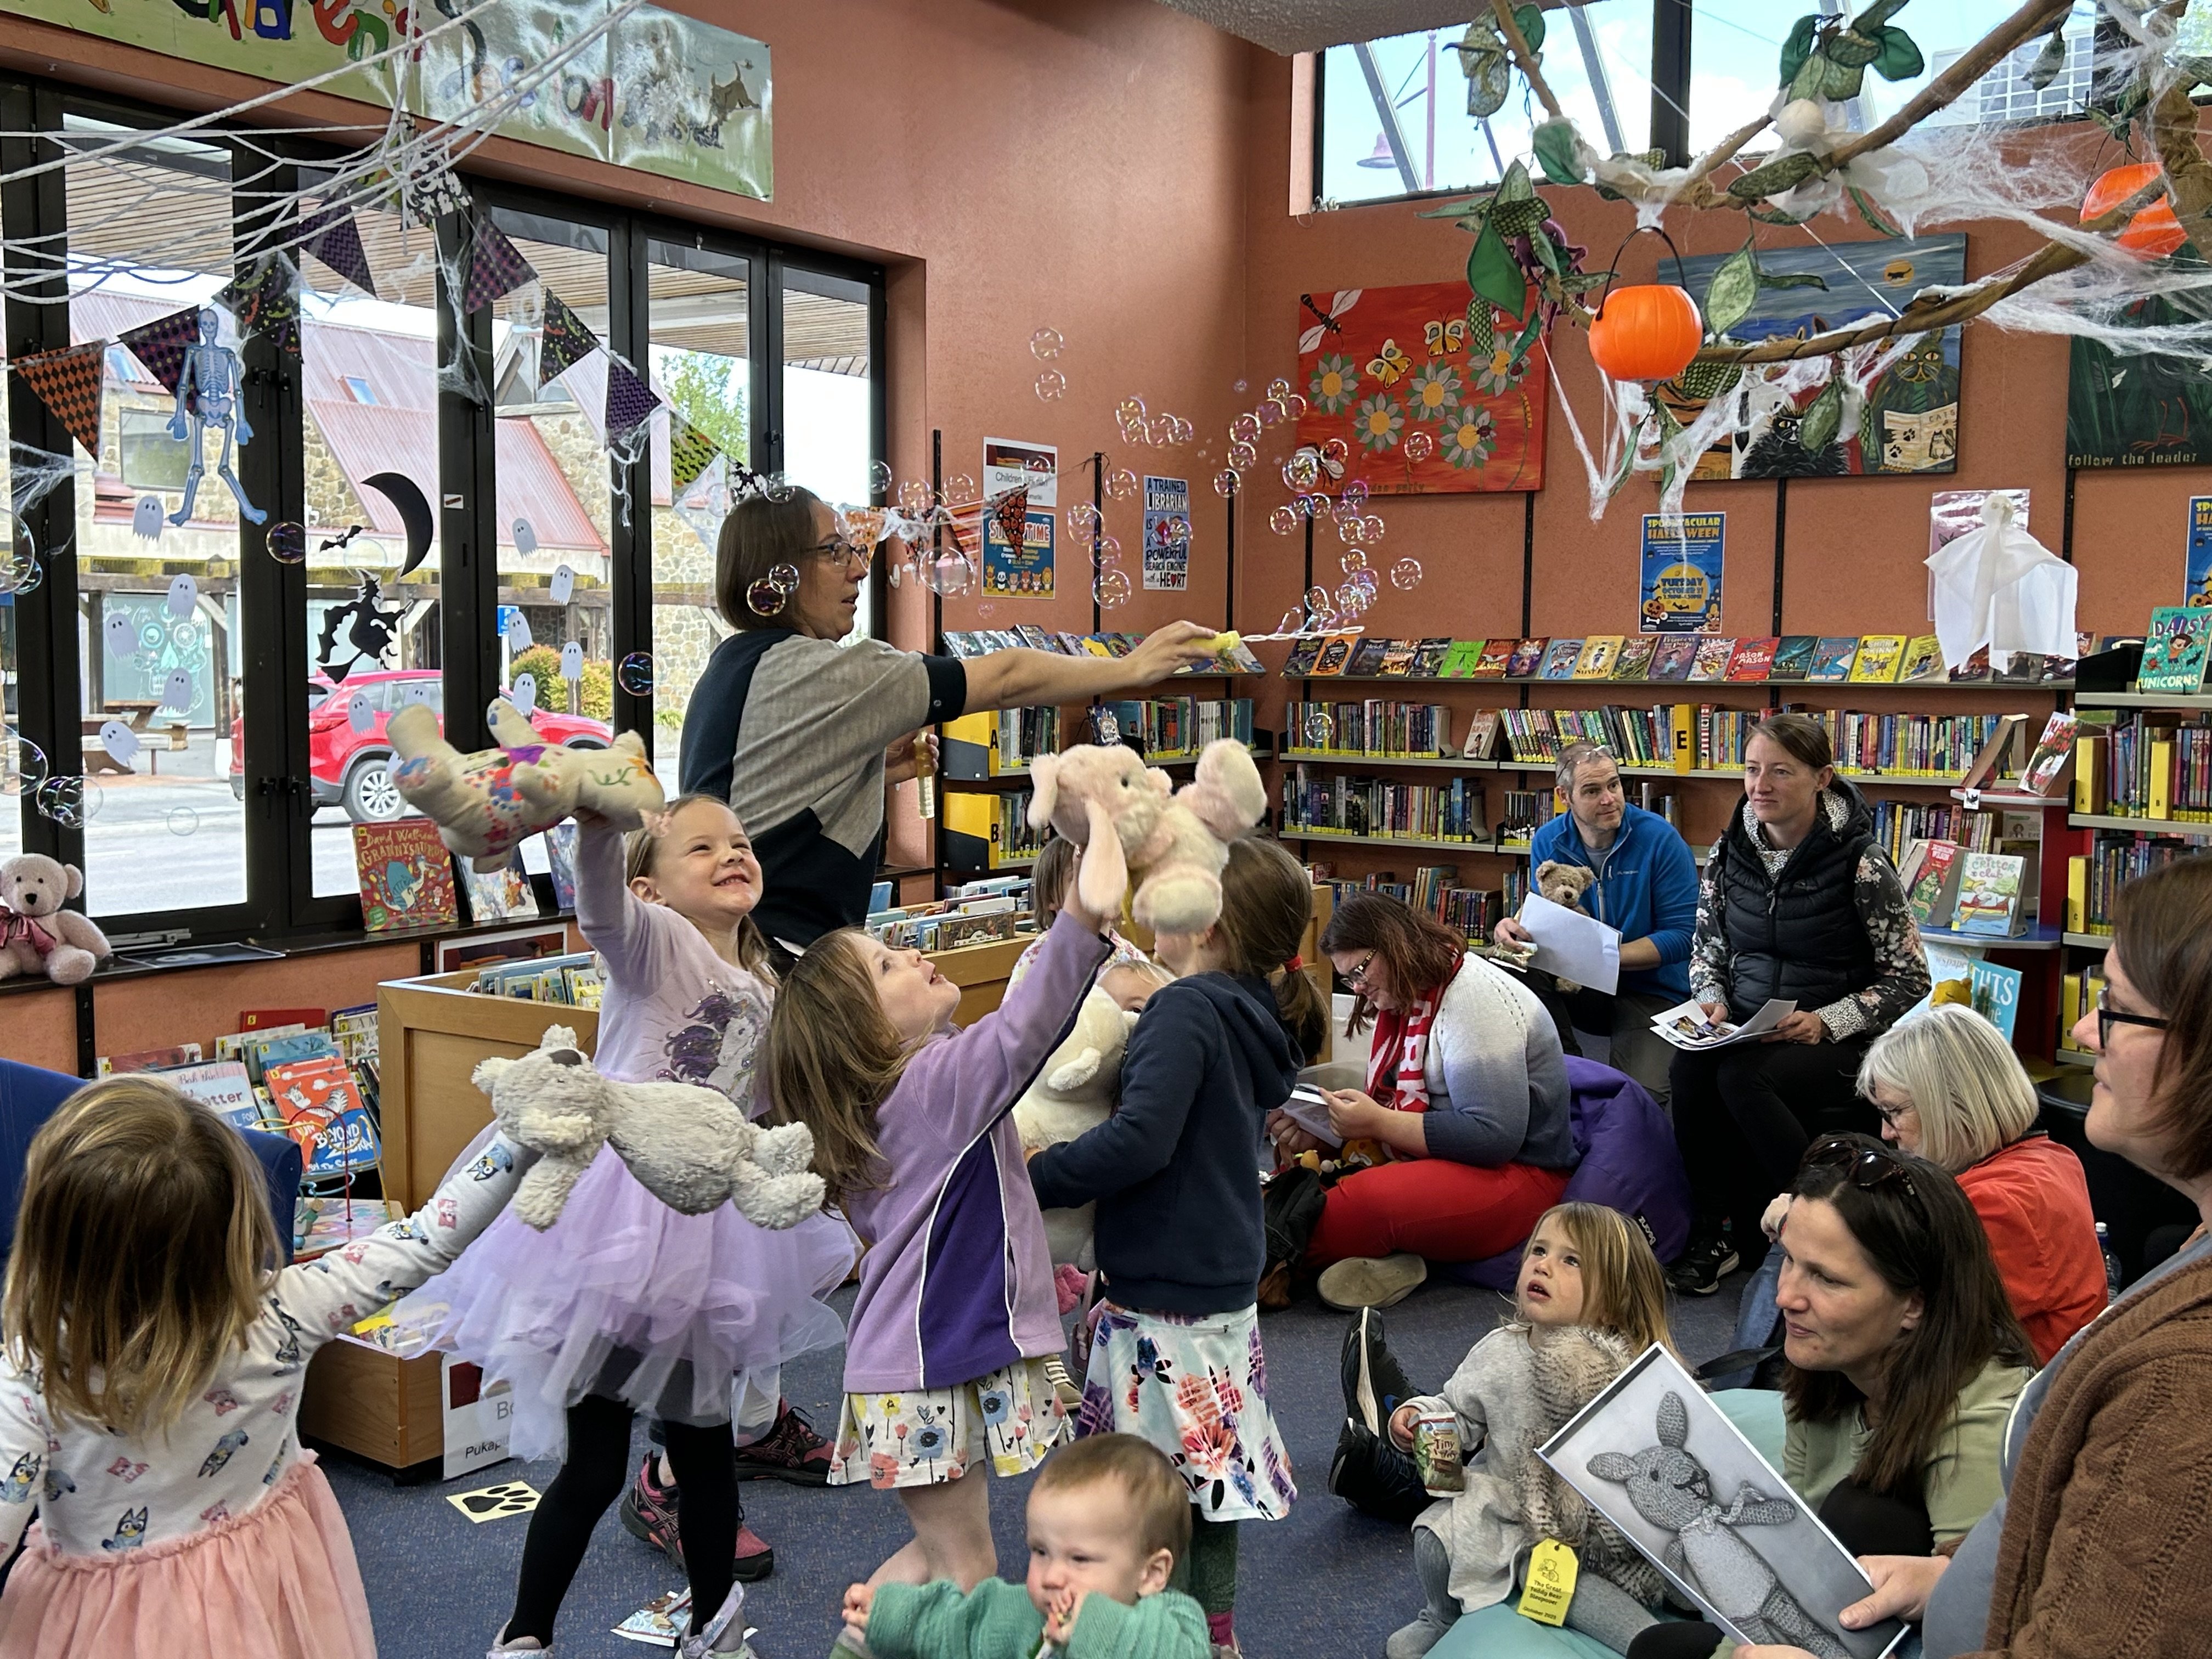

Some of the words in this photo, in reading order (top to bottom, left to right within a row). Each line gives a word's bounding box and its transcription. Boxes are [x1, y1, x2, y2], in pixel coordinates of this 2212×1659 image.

[1929, 409, 1955, 422] CATS
[2068, 454, 2114, 466] follow
[2122, 452, 2145, 465] the
[2151, 452, 2198, 464] leader
[1147, 478, 1152, 490] A
[1153, 479, 1186, 493] TRAINED
[1146, 492, 1188, 512] LIBRARIAN
[1146, 517, 1152, 530] IS
[1146, 537, 1151, 548] A
[2153, 613, 2212, 639] DAISY
[1734, 651, 1764, 660] JASON
[1738, 656, 1771, 664] MASON
[2140, 674, 2199, 689] UNICORNS
[990, 730, 998, 749] A
[1677, 730, 1687, 749] E
[991, 823, 998, 843] B
[360, 841, 444, 866] GRANNYSAURUS
[1972, 965, 2015, 1006] THIS
[311, 1122, 360, 1149] BEYOND
[1434, 1439, 1455, 1450] Tiny
[1534, 1579, 1544, 1588] The
[1545, 1583, 1562, 1592] Great
[1530, 1587, 1548, 1597] Teddy
[1548, 1592, 1562, 1600] Bear
